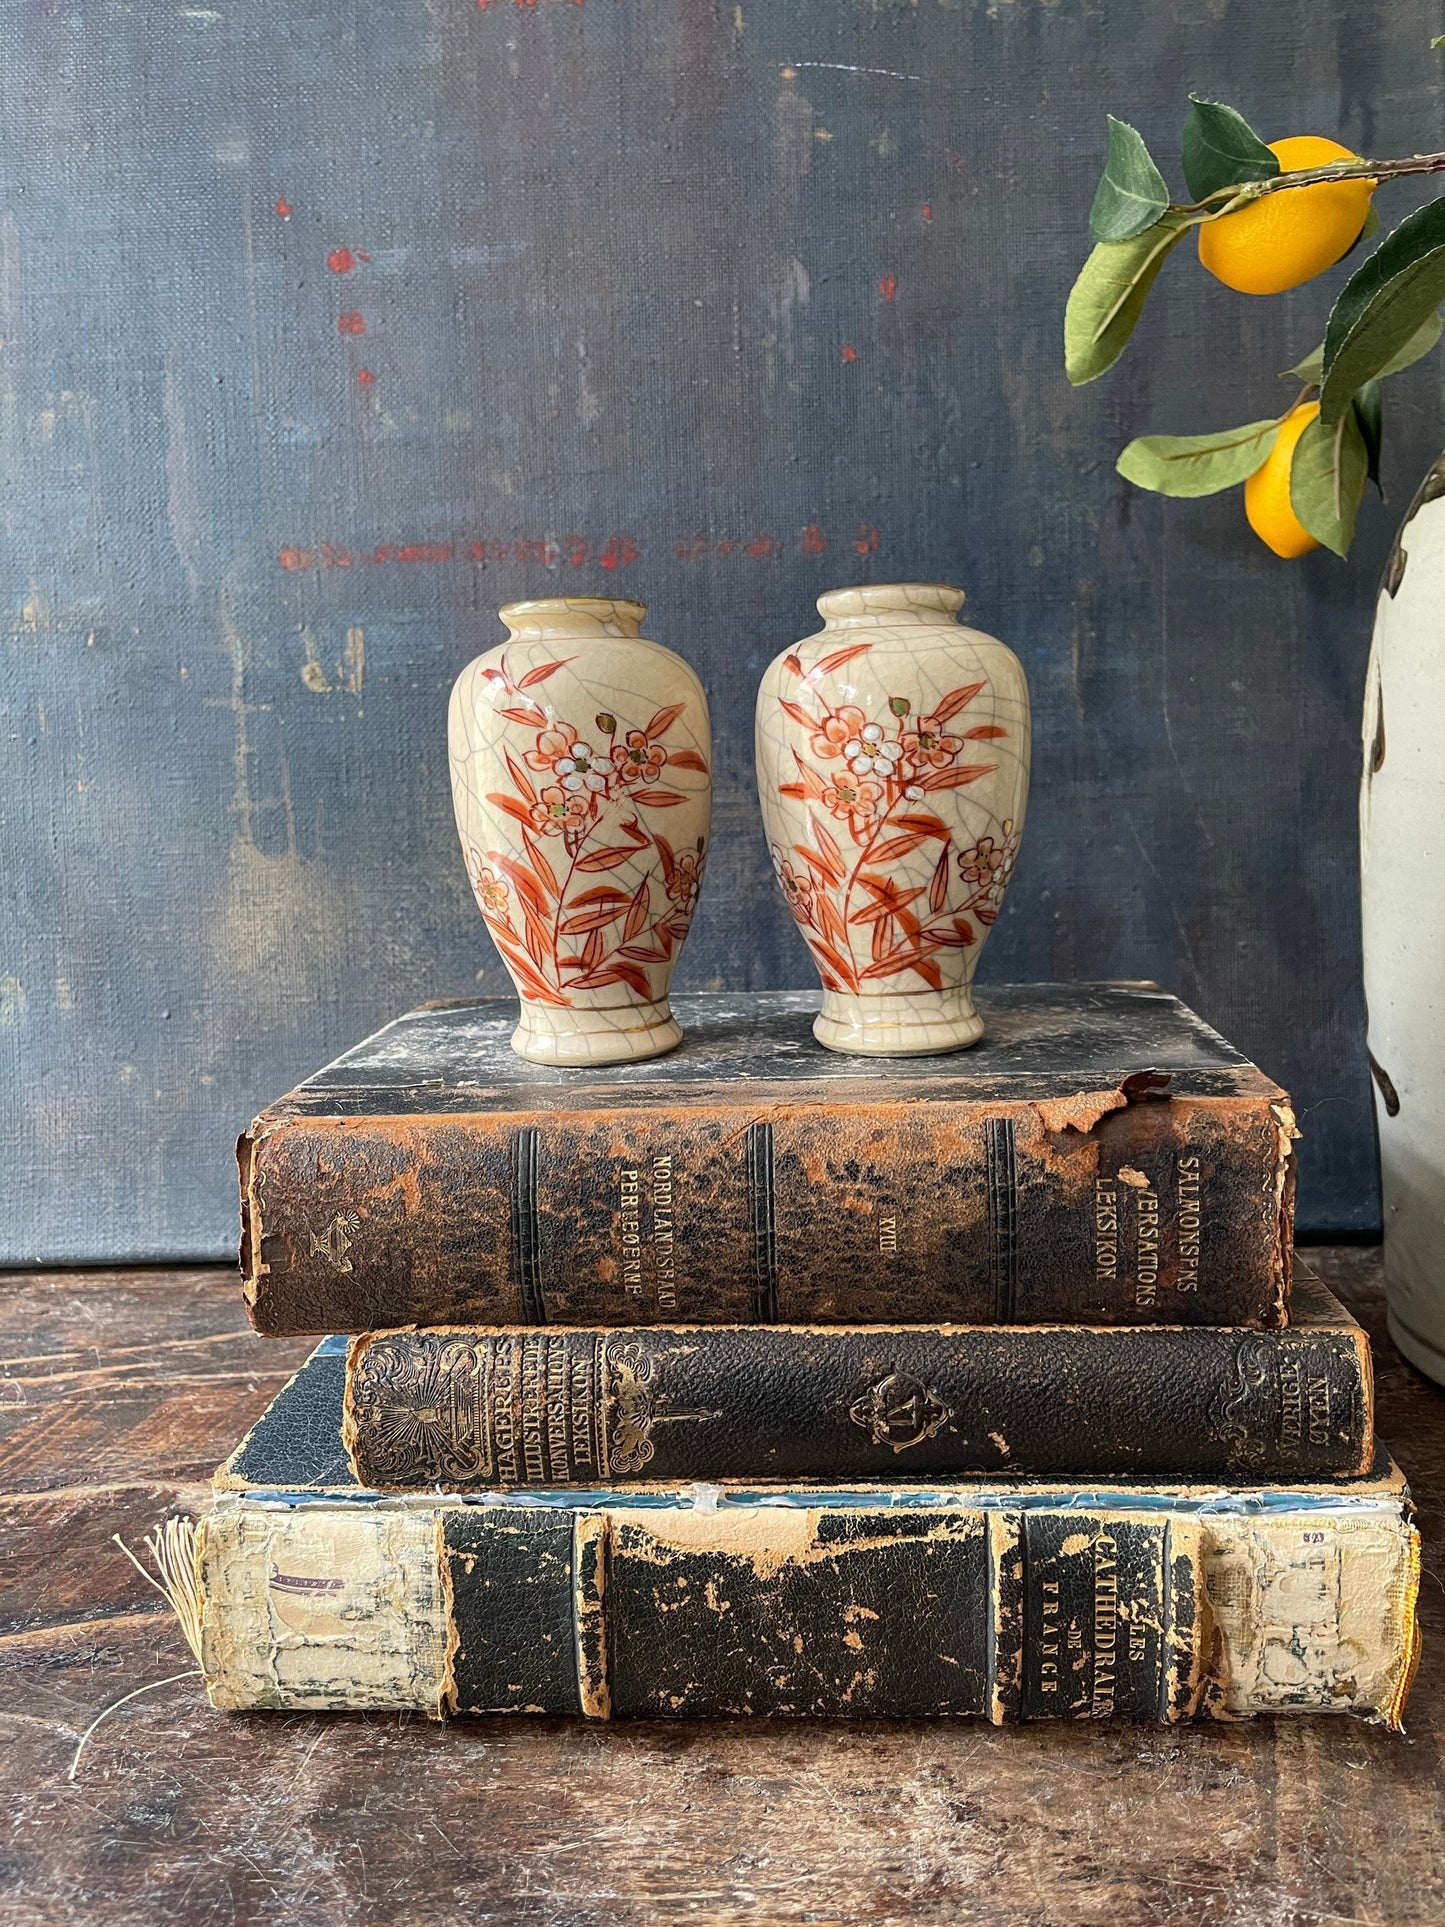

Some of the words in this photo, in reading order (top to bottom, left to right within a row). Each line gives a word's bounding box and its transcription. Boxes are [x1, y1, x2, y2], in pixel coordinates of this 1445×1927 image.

[620, 1169, 642, 1294] PERLEØERNE
[653, 1154, 676, 1308] NORDLANDSBAAD
[879, 1214, 897, 1251] XVIII
[1095, 1178, 1117, 1280] LEKSIKON
[1177, 1156, 1200, 1292] SALMONSENS
[494, 1333, 517, 1482] HAGERUPS
[522, 1331, 545, 1481] ILLUSTREREDE
[548, 1336, 570, 1481] KONVERSATIONS
[571, 1356, 593, 1465] LEKSIKON
[1308, 1375, 1330, 1446] ØYEN
[1040, 1581, 1059, 1692] FRANCE
[1067, 1629, 1082, 1649] DE
[1129, 1622, 1146, 1662] LES
